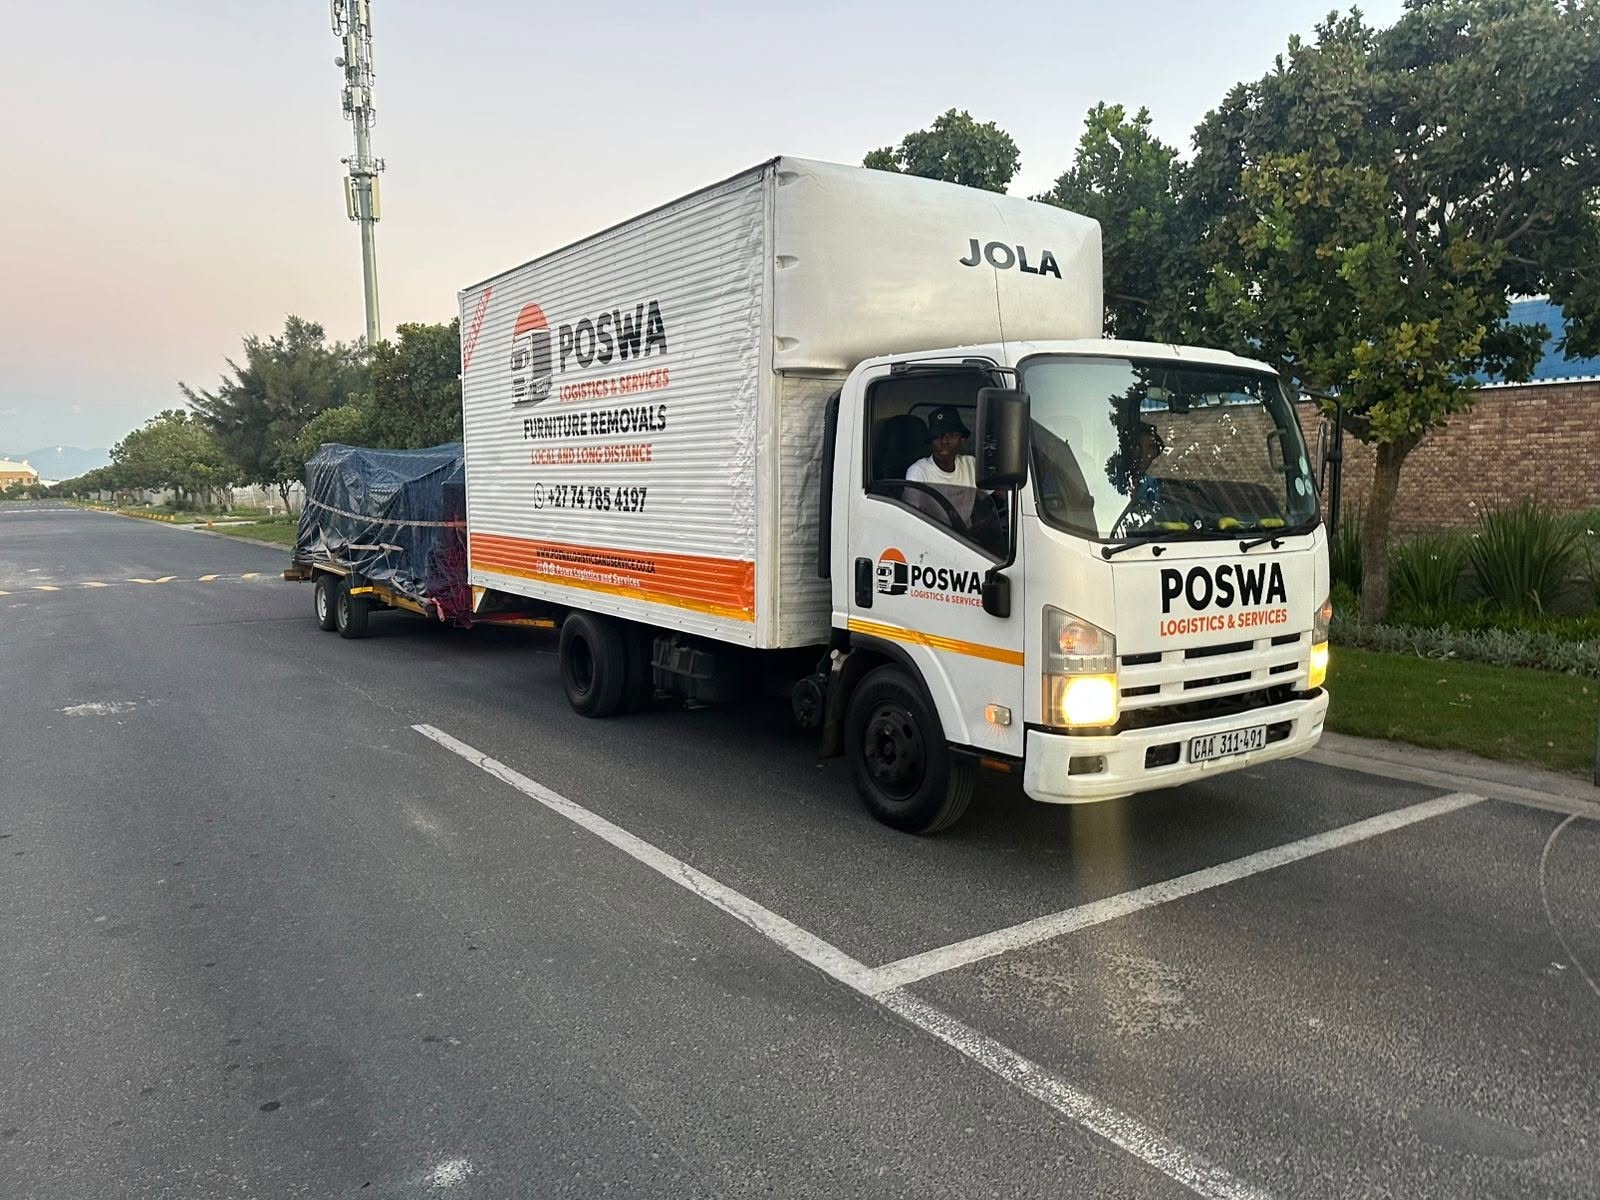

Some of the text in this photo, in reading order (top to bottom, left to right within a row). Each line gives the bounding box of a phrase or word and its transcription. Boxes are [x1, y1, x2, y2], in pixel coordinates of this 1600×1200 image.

[959, 238, 1062, 279] JOLA
[559, 300, 667, 373] POSWA
[559, 368, 670, 402] LOGISTICS & SERVICES
[524, 404, 667, 439] FURNITURE REMOVALS
[531, 443, 652, 464] LOCAL AND LONG DISTANCE
[548, 485, 647, 512] +27 74 785 4197
[911, 565, 982, 595] POSWA
[1160, 562, 1287, 613] POSWA
[911, 589, 944, 602] LOGISTICS
[945, 594, 950, 603] &
[1160, 608, 1288, 637] LOGISTICS & SERVICES
[1194, 738, 1214, 759] CAA
